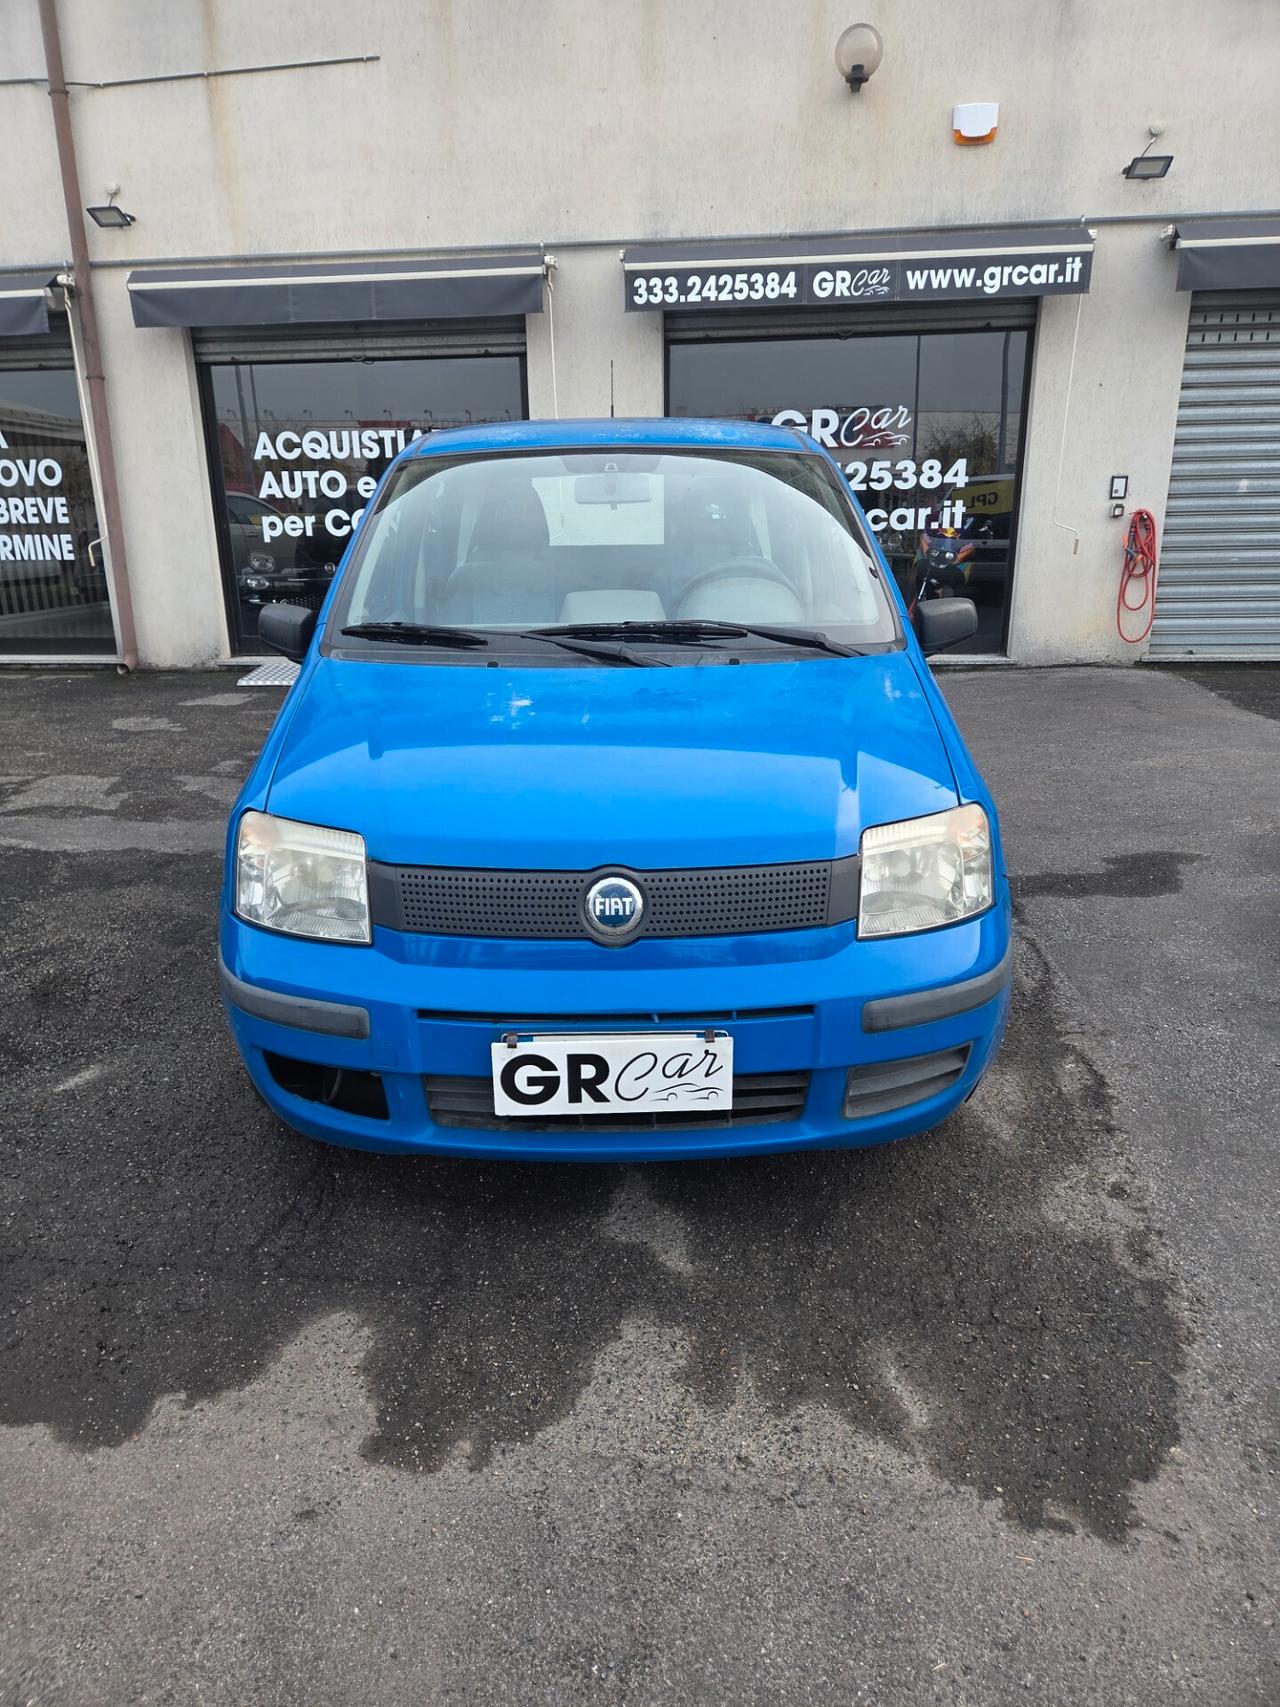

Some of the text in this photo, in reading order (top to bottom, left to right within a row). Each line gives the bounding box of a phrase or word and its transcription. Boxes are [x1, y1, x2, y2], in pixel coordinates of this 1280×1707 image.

[633, 270, 797, 305] 333.2425384
[906, 256, 1082, 294] www.grcar.it
[253, 429, 440, 461] ACQUISTI
[258, 469, 378, 500] AUTO e
[836, 458, 969, 491] 25384
[261, 514, 316, 543] per
[861, 499, 966, 532] car.it
[595, 897, 633, 916] FIAT
